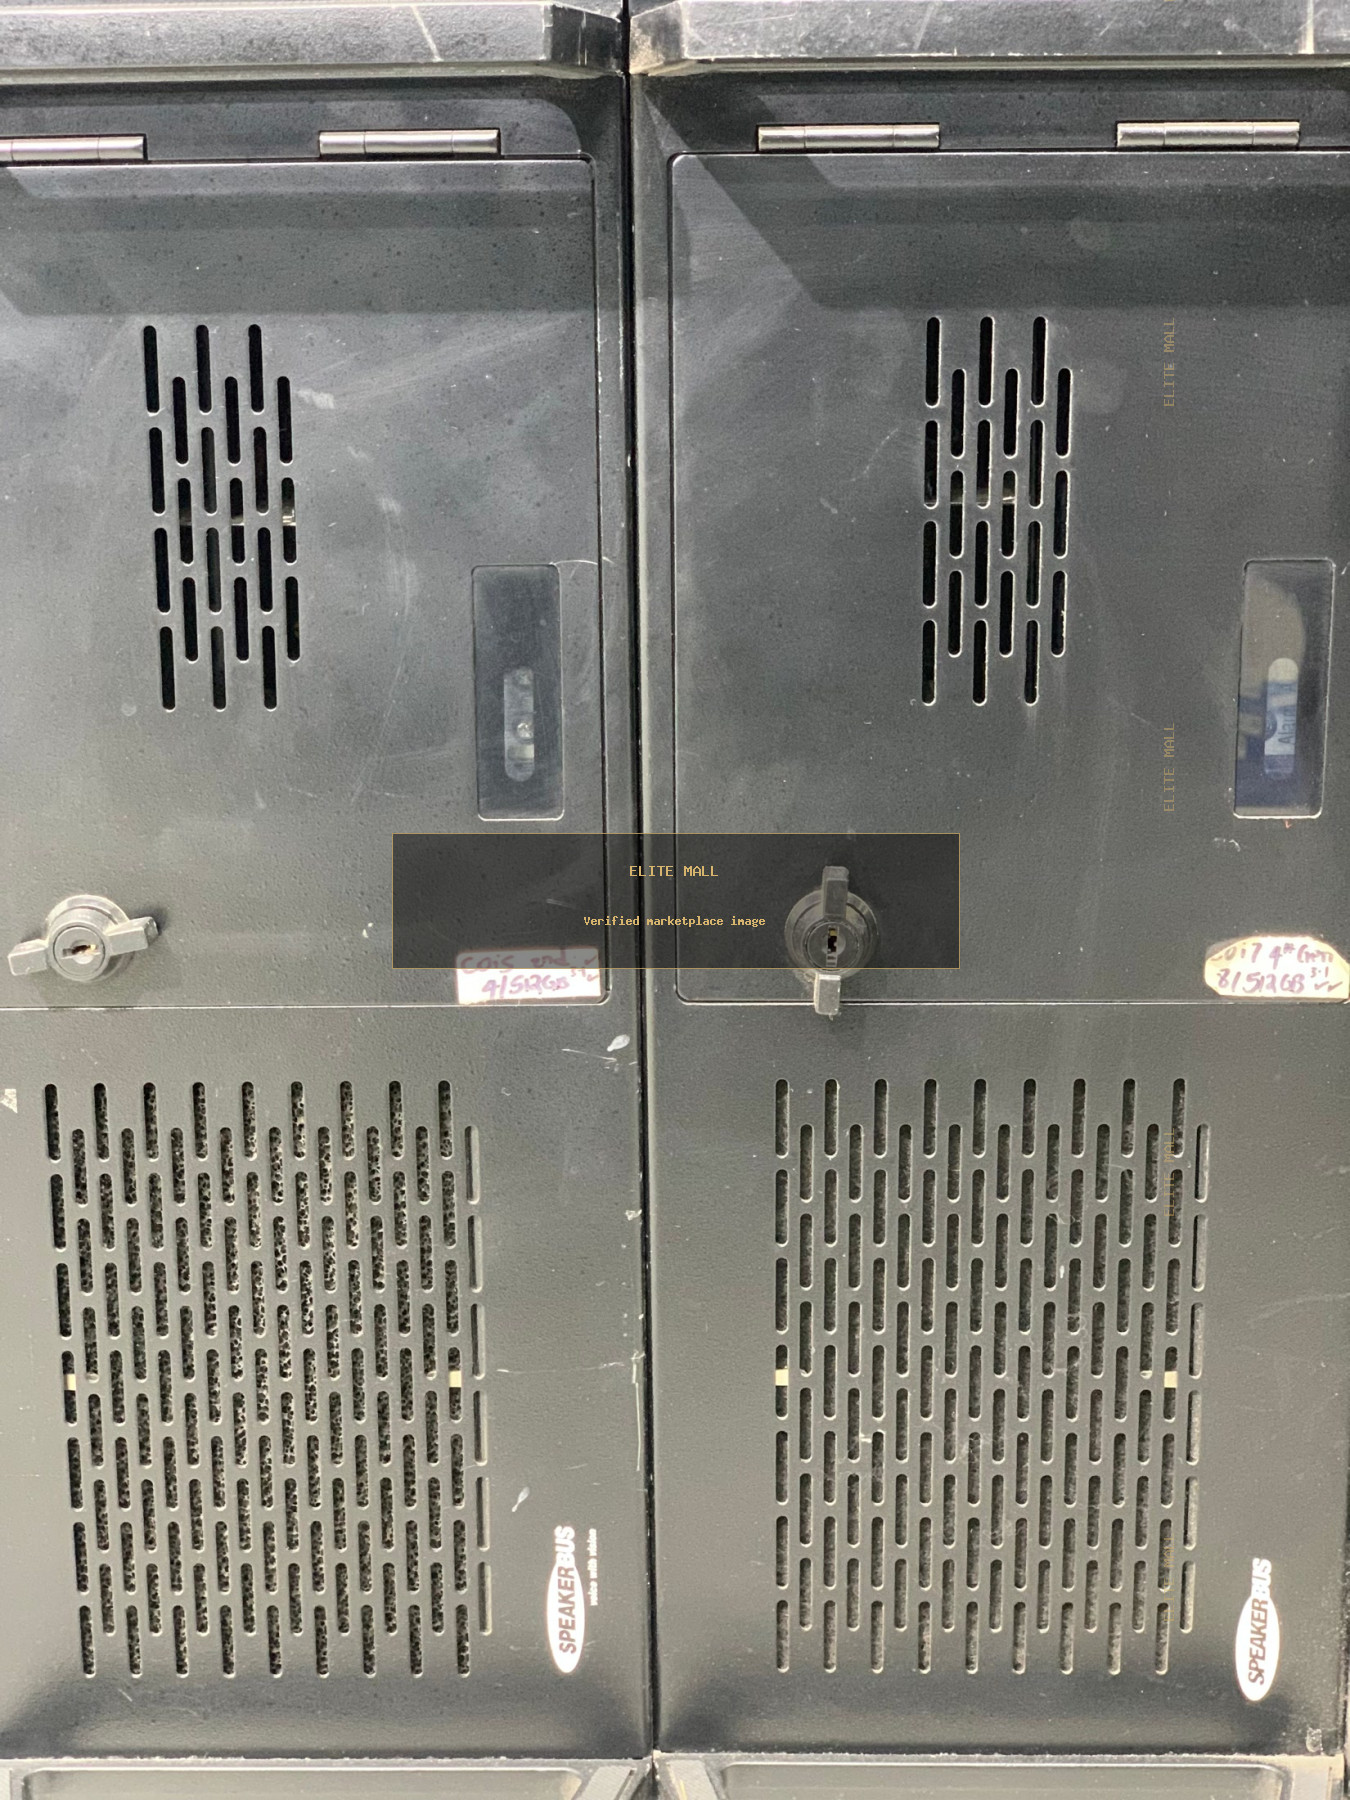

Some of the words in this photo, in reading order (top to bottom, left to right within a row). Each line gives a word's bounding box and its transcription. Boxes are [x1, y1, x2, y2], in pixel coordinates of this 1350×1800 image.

[587, 1528, 598, 1556] vision
[587, 1558, 598, 1579] with
[588, 1581, 599, 1607] voice
